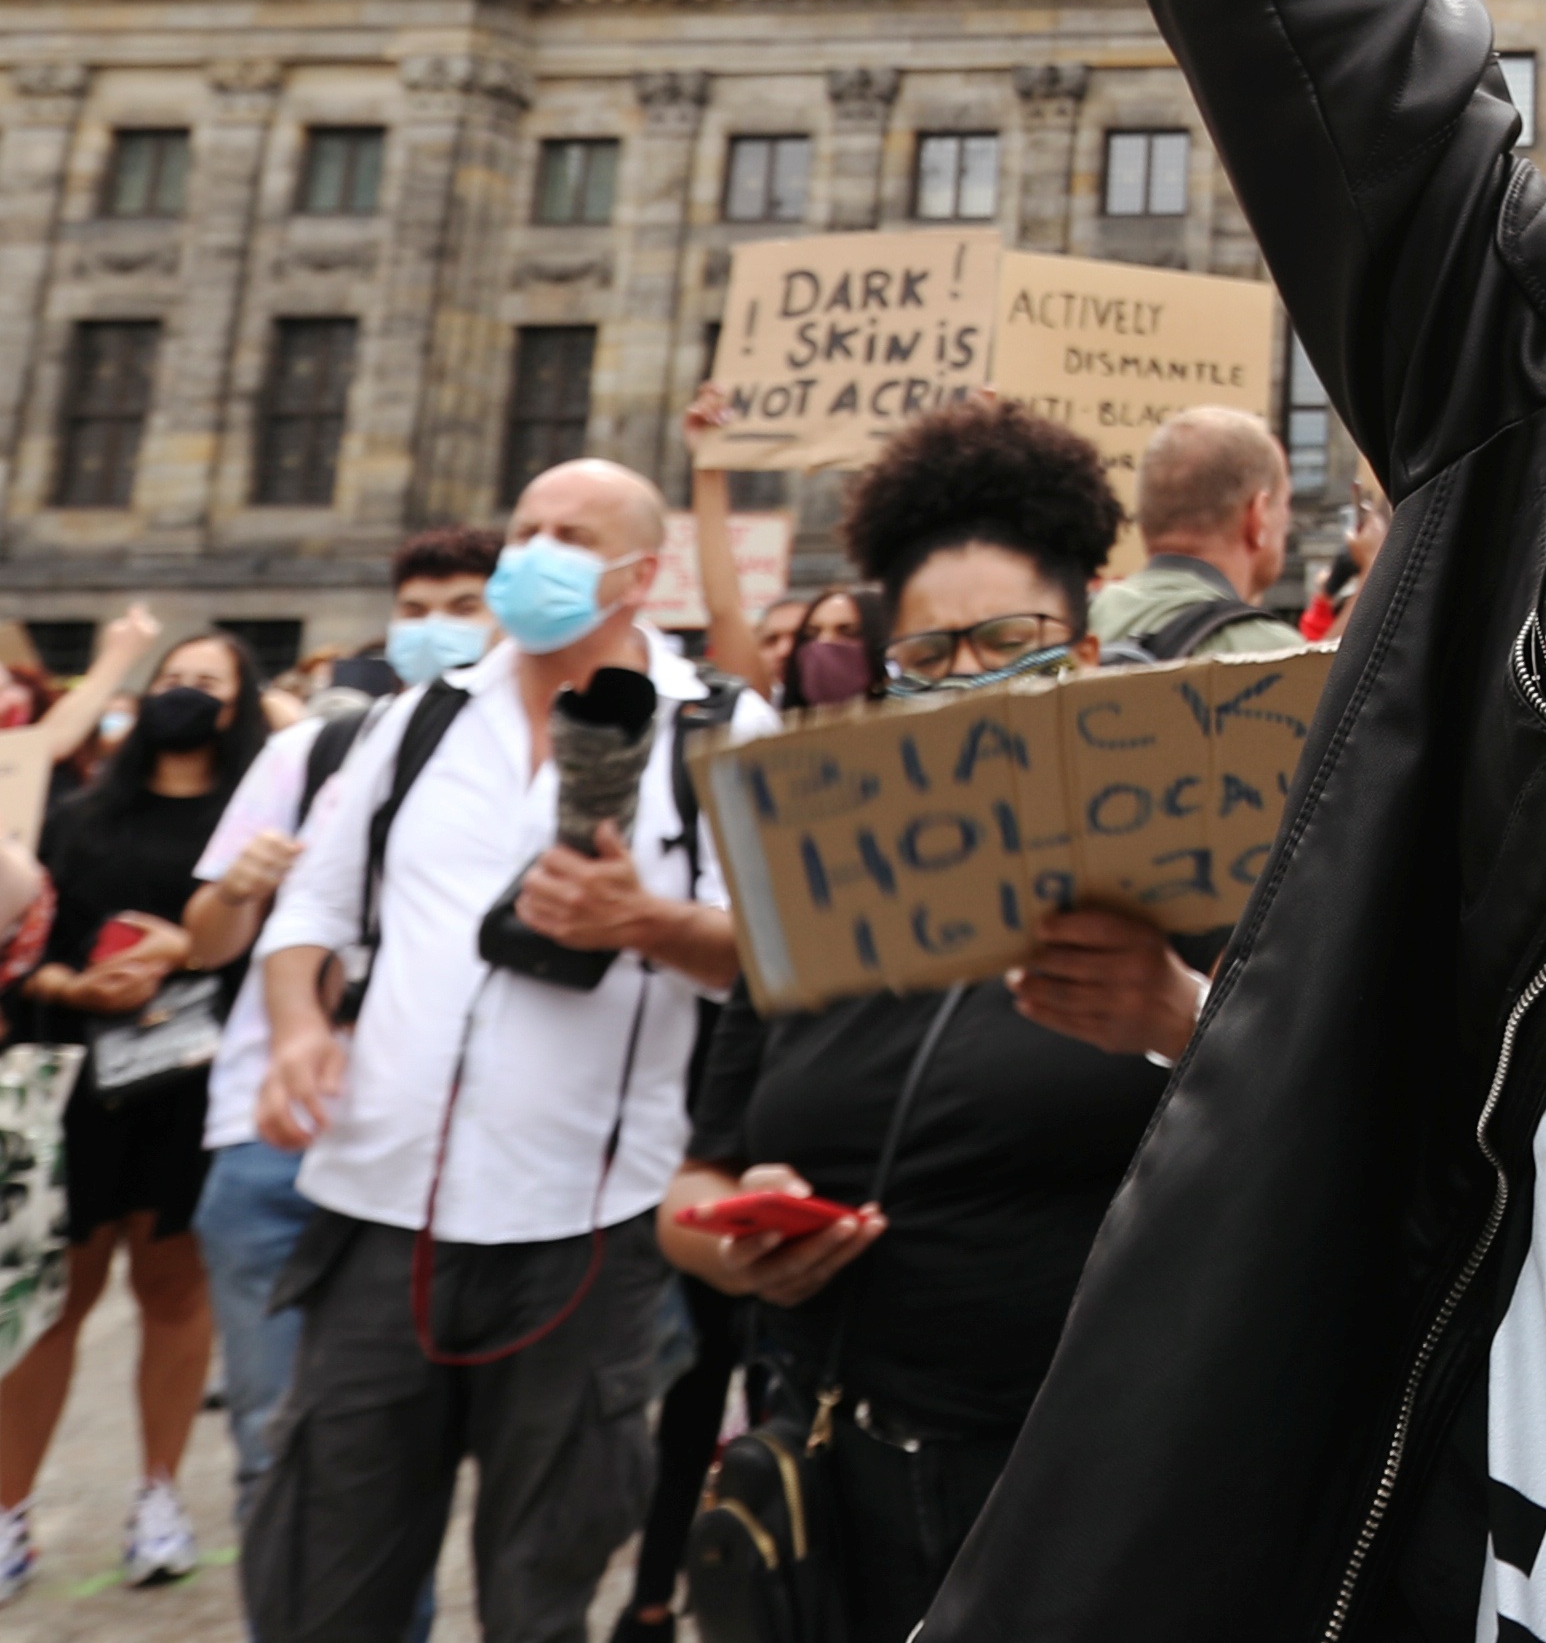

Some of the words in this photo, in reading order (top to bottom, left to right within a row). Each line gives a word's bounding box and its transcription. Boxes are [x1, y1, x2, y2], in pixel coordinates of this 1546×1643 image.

[778, 268, 930, 319] DARK
[1006, 288, 1166, 337] ACTIVELY
[1062, 346, 1246, 387] DISMANTLE
[729, 375, 818, 420] NOT
